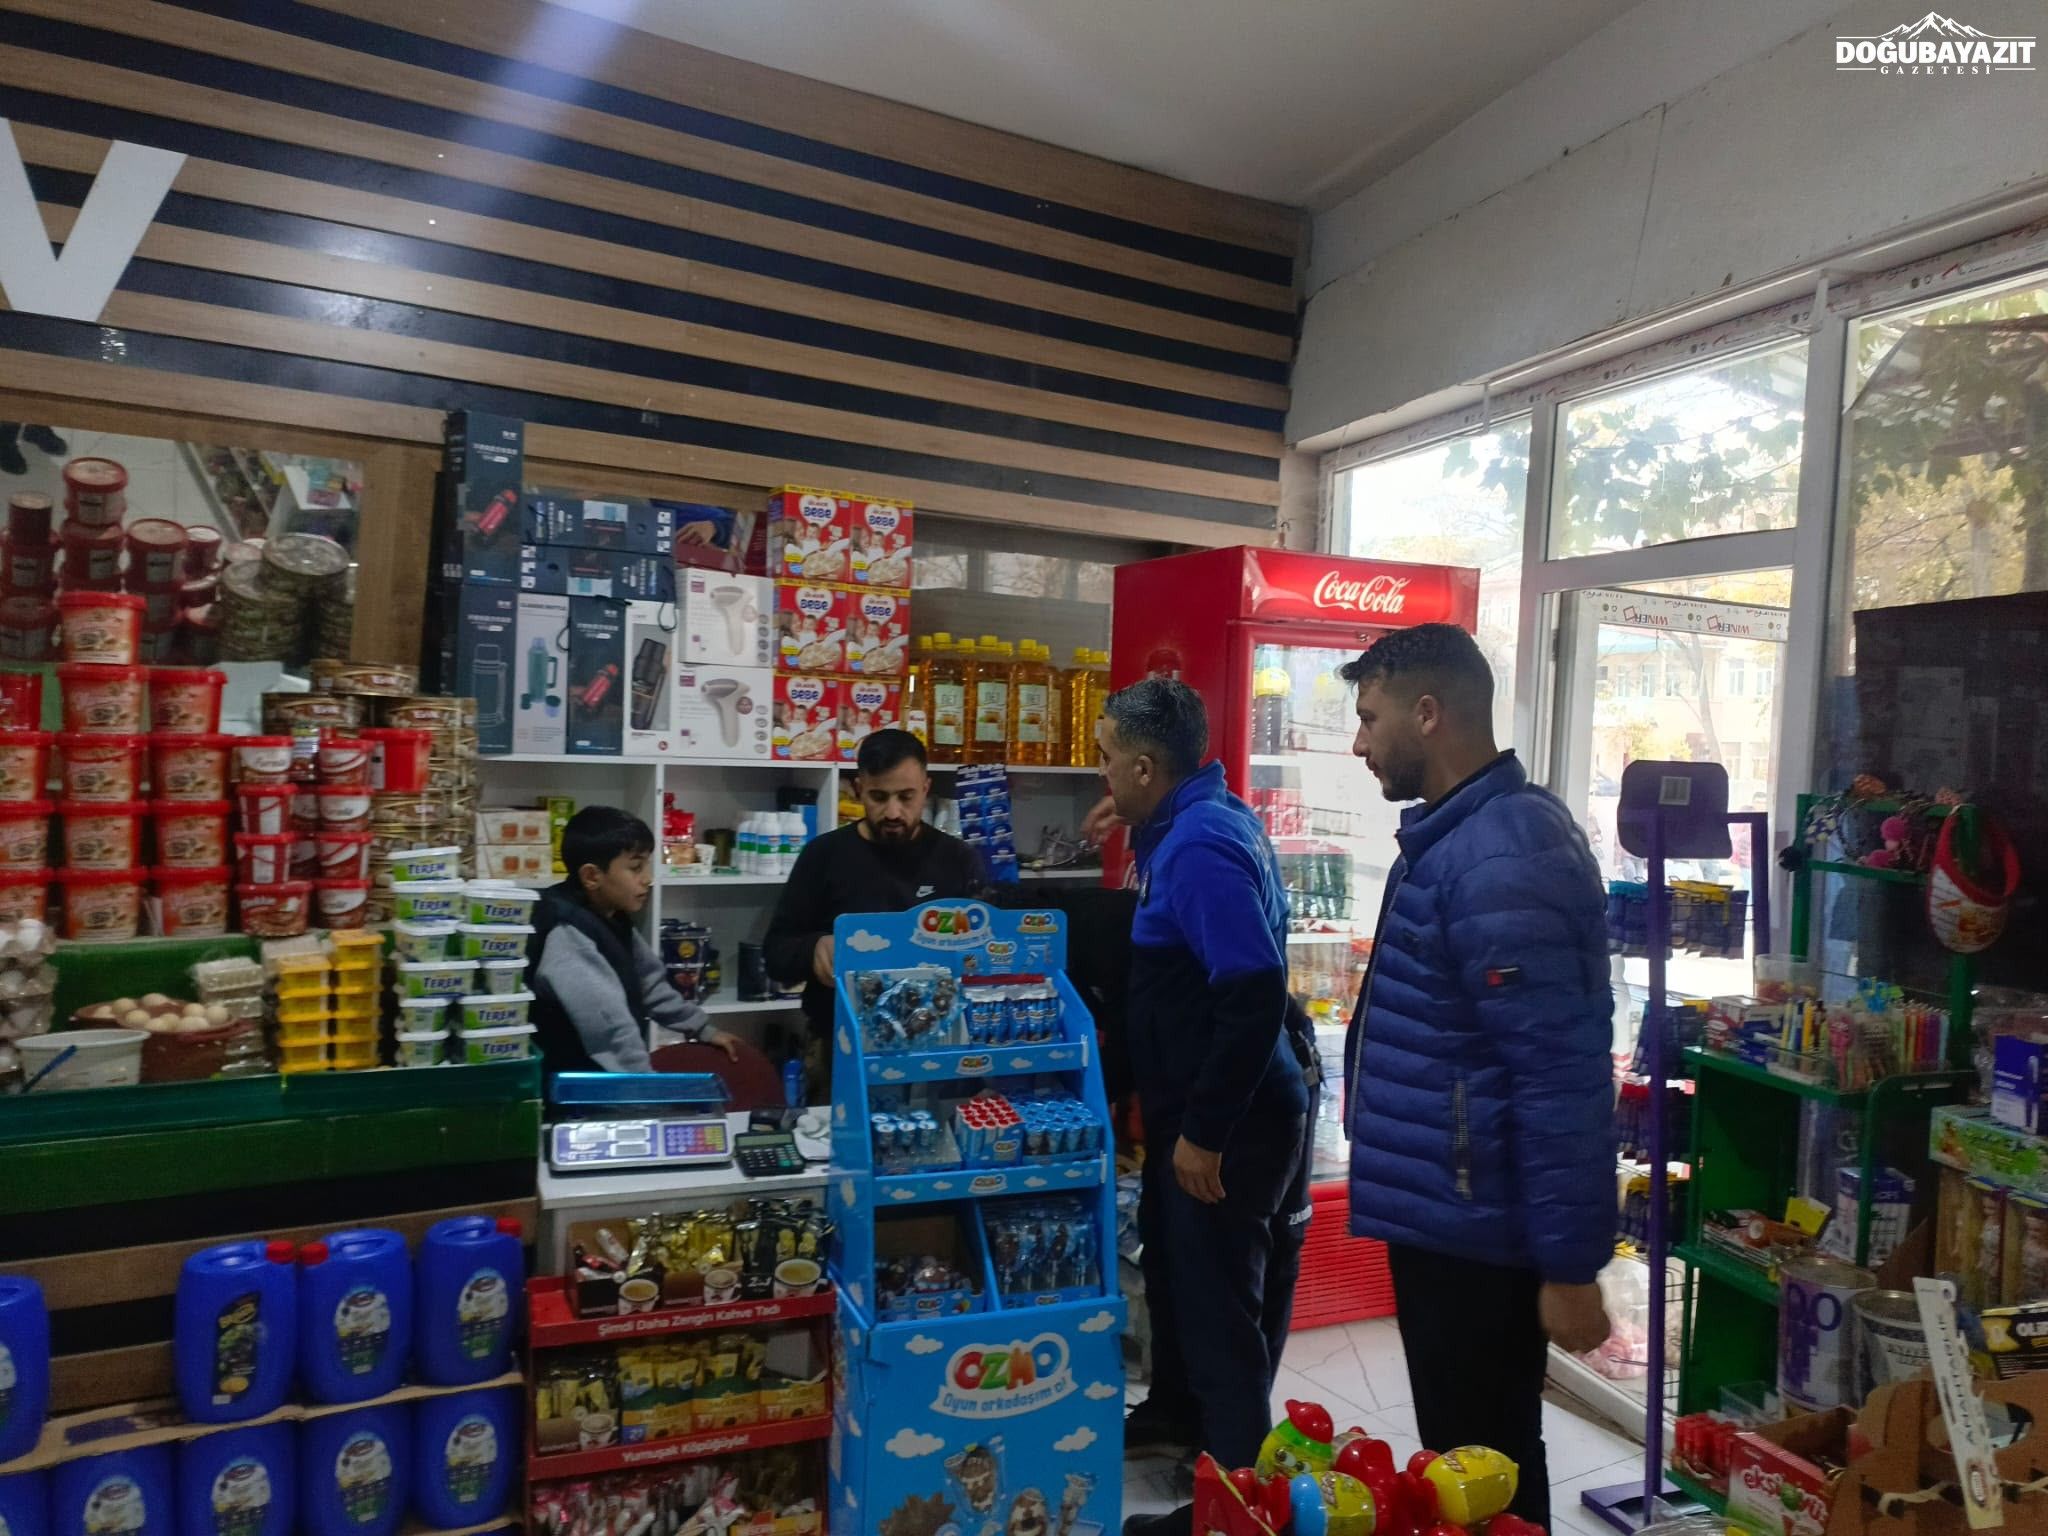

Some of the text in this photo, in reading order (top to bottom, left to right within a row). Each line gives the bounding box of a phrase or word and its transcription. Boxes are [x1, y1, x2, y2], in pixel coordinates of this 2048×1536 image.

[1313, 571, 1412, 614] Coca-Cola
[955, 1340, 1062, 1390] OZMO
[943, 1393, 977, 1413] Oyun
